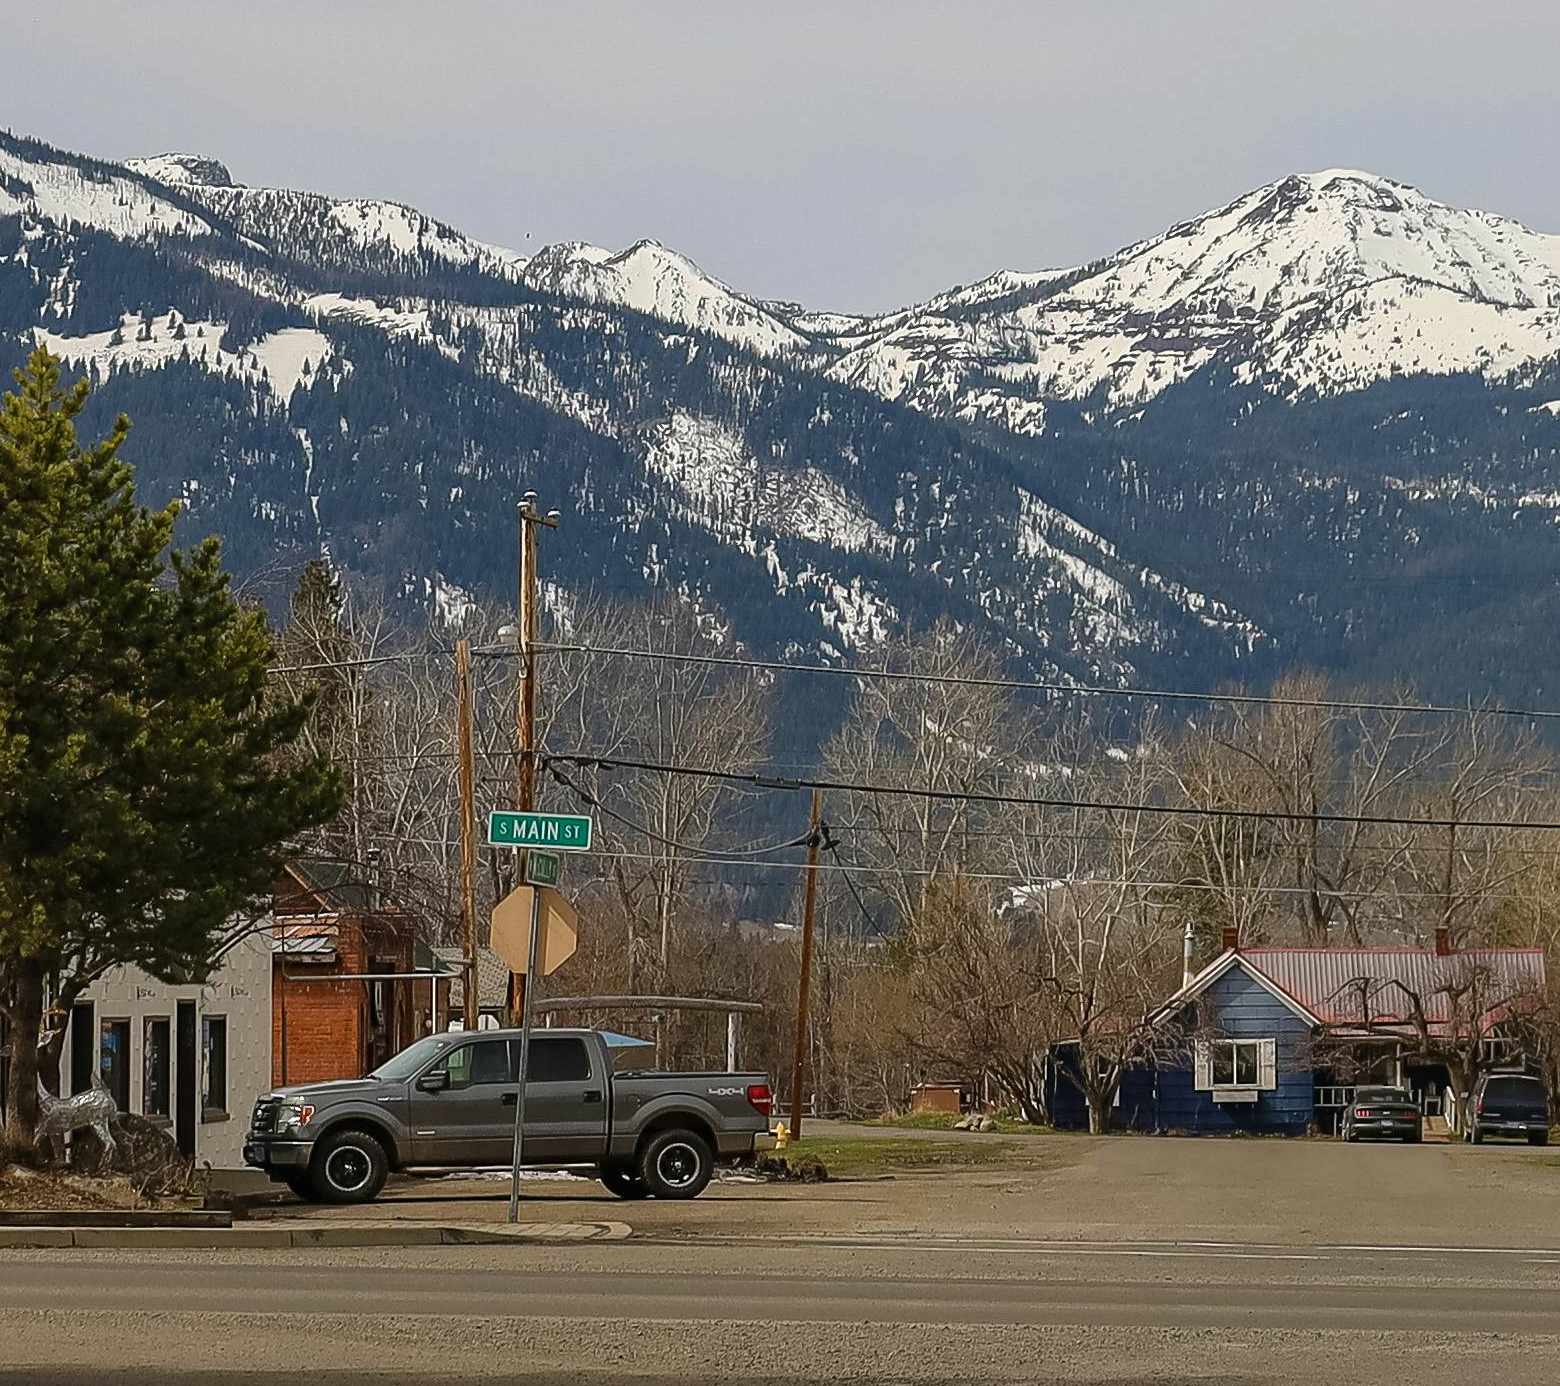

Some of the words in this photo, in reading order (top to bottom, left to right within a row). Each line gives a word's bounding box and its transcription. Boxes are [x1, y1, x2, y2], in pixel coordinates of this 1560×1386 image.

[499, 821, 508, 835] S
[513, 819, 559, 841] MAIN
[564, 825, 580, 839] ST
